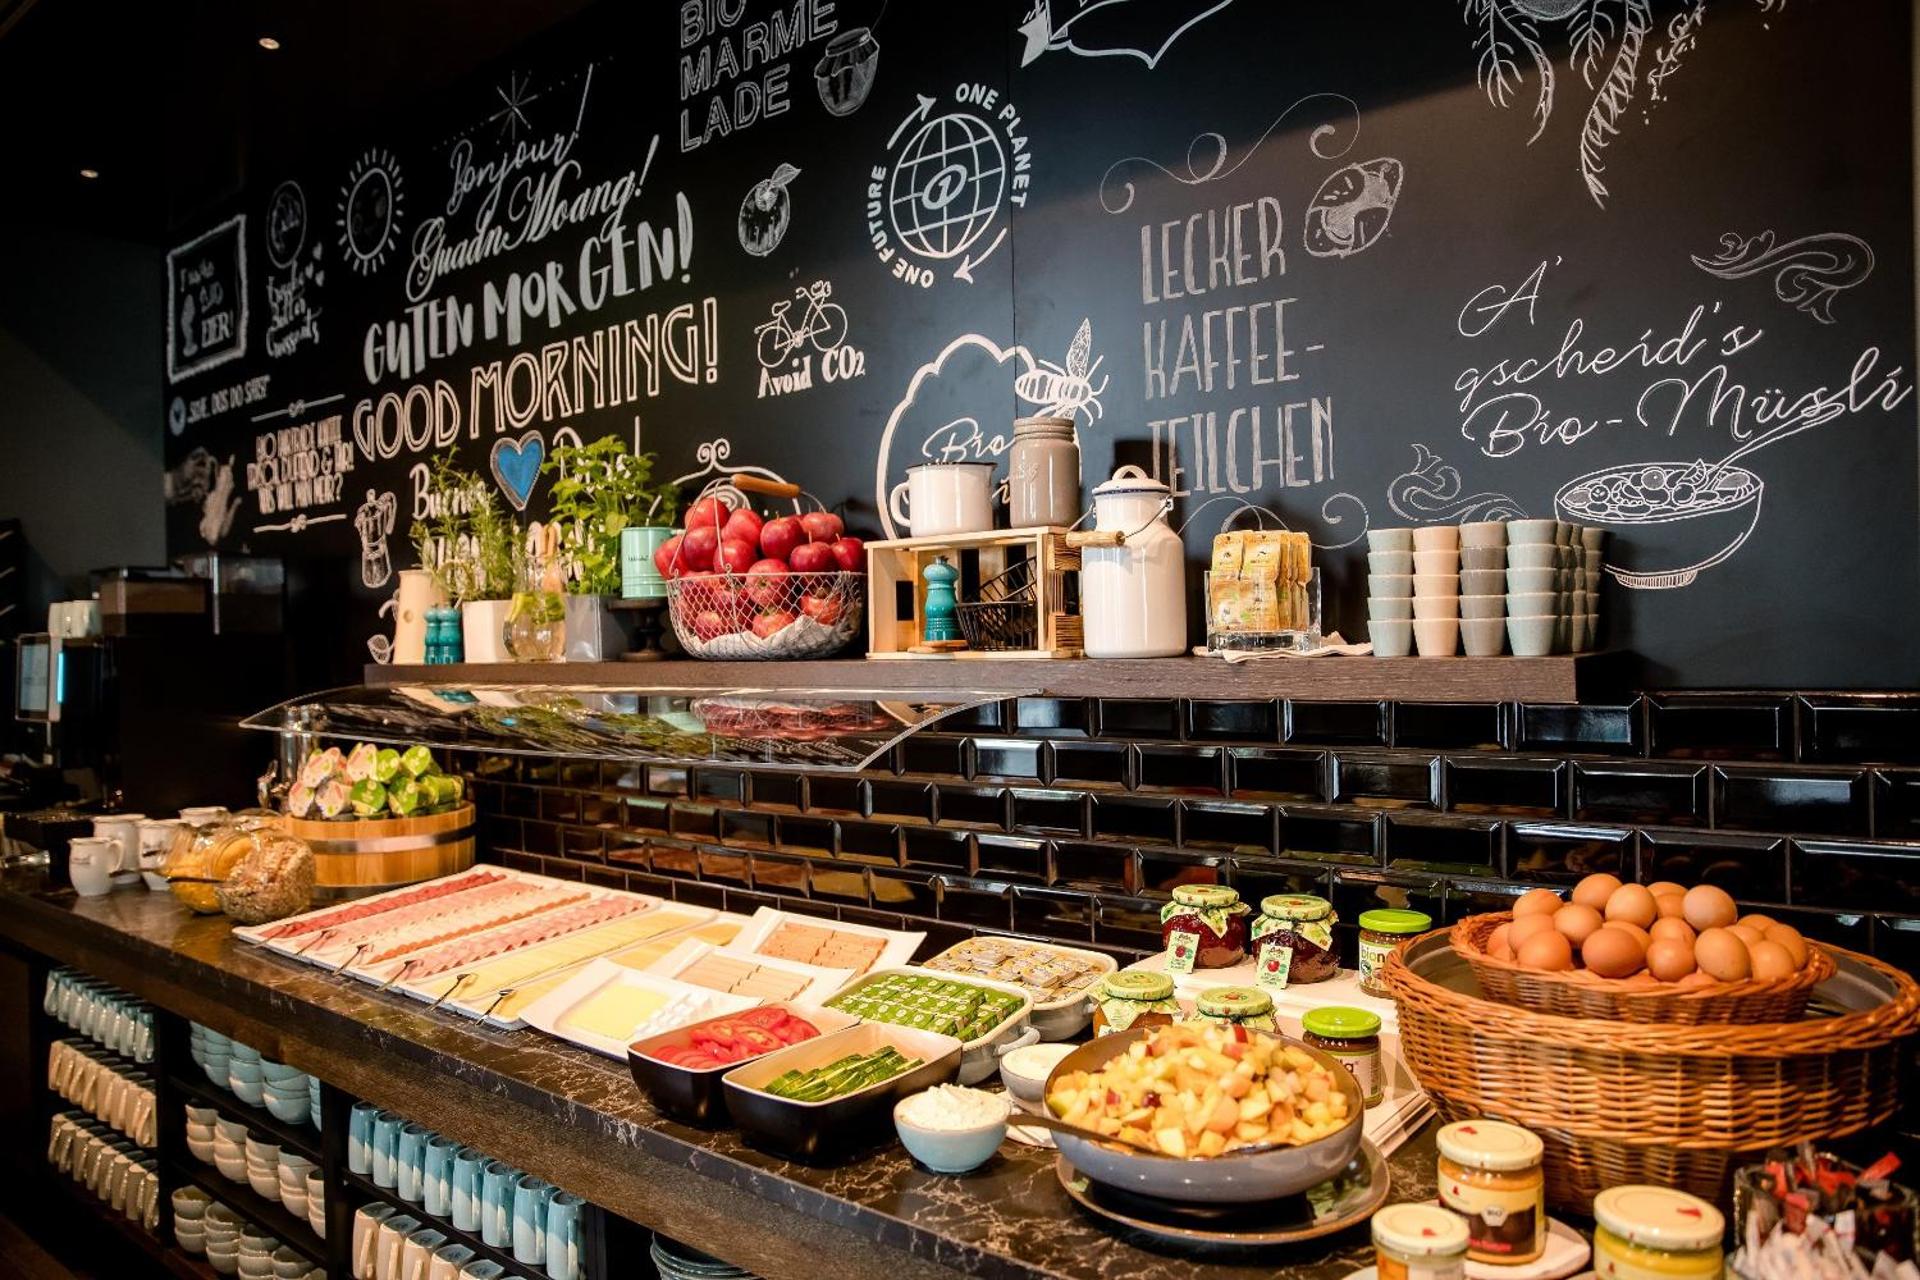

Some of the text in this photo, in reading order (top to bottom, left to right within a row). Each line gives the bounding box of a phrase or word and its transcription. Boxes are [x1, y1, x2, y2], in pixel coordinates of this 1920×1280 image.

[680, 0, 747, 48] BIO
[446, 62, 594, 234] Bonjour!
[680, 63, 791, 153] LADE
[955, 82, 1032, 208] ONE PLANET
[867, 164, 935, 289] ONE FUTURE
[1140, 196, 1286, 305] LECKER
[363, 295, 474, 386] GUTEN
[483, 191, 694, 346] MORGEN!
[352, 378, 461, 463] GOOD
[469, 297, 718, 439] MORNING!
[757, 345, 867, 400] Avoid CO2
[1143, 297, 1325, 400] KAFFEE-
[1146, 396, 1335, 497] TEILCHEN
[1361, 944, 1386, 963] bion
